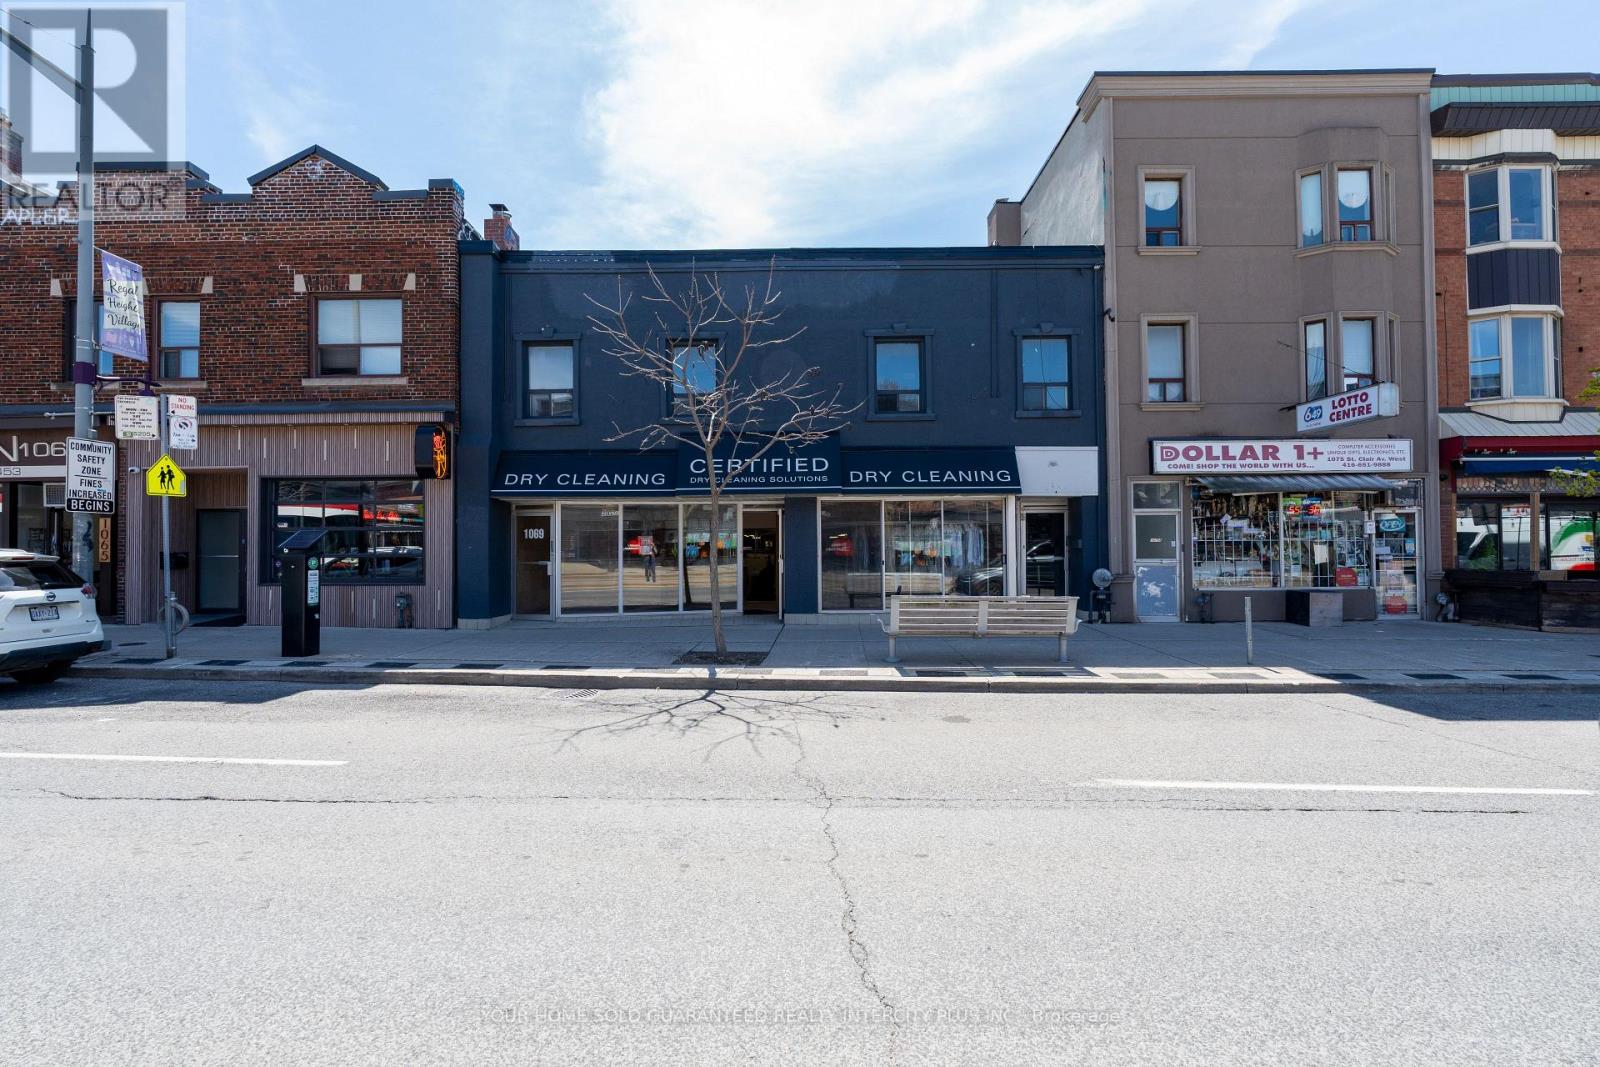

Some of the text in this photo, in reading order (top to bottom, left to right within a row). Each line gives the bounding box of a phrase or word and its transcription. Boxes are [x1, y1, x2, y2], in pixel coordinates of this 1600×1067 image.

[107, 278, 138, 297] Regal
[107, 297, 139, 313] Height
[170, 403, 195, 411] STANDING
[1331, 391, 1369, 410] LOTTO
[1329, 403, 1372, 422] CENTRE
[70, 442, 112, 454] COMMUNITY
[1160, 444, 1324, 462] DOLLAR 1+
[77, 454, 106, 464] SAFETY
[689, 457, 829, 474] CERTIFIED
[81, 466, 102, 475] ZONE
[850, 470, 1012, 483] DRY CLEANING
[80, 479, 103, 488] FINES
[504, 473, 667, 486] DRY CLEANING
[769, 475, 828, 483] SOLUTIONS
[69, 489, 112, 500] INCREASED
[71, 499, 110, 512] BEGINS
[100, 518, 109, 560] 1065
[524, 528, 545, 540] 1069
